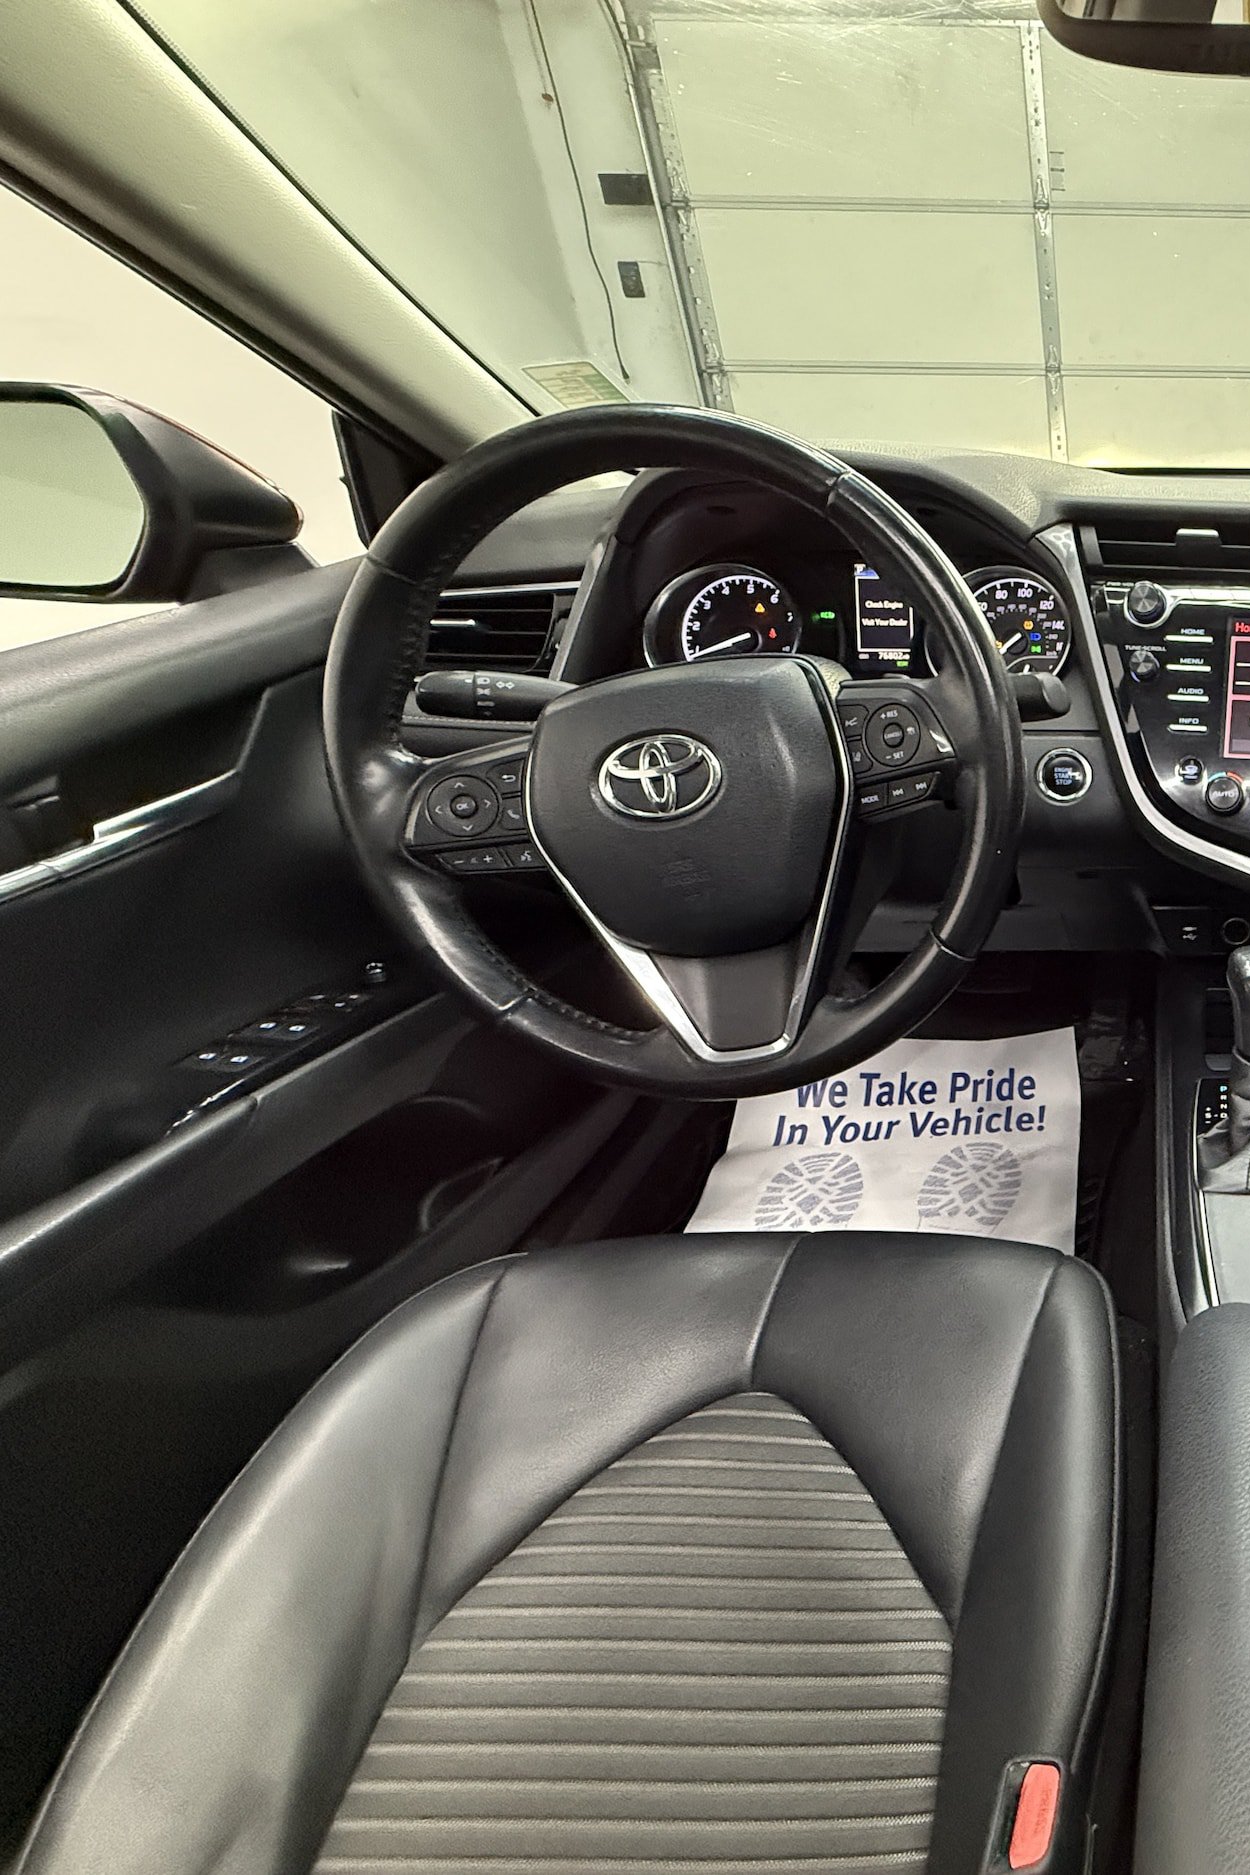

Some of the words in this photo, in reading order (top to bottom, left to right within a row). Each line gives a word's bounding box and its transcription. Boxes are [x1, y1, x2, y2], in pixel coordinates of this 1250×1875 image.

[746, 585, 755, 595] 5
[995, 589, 1008, 600] 80
[1017, 588, 1033, 598] 100
[770, 594, 779, 604] 6
[703, 601, 711, 610] 3
[1040, 600, 1054, 610] 120
[691, 620, 701, 632] 2
[1180, 628, 1206, 636] HOME
[1179, 657, 1205, 665] MENU
[1177, 687, 1204, 695] AUDIO
[1178, 717, 1200, 725] INFO
[1211, 790, 1236, 798] AUTO
[796, 1076, 849, 1109] We
[859, 1071, 938, 1107] Take
[949, 1067, 1037, 1104] Pride
[772, 1115, 809, 1148] In
[821, 1114, 900, 1146] Your
[909, 1105, 1046, 1138] Vehicle!
